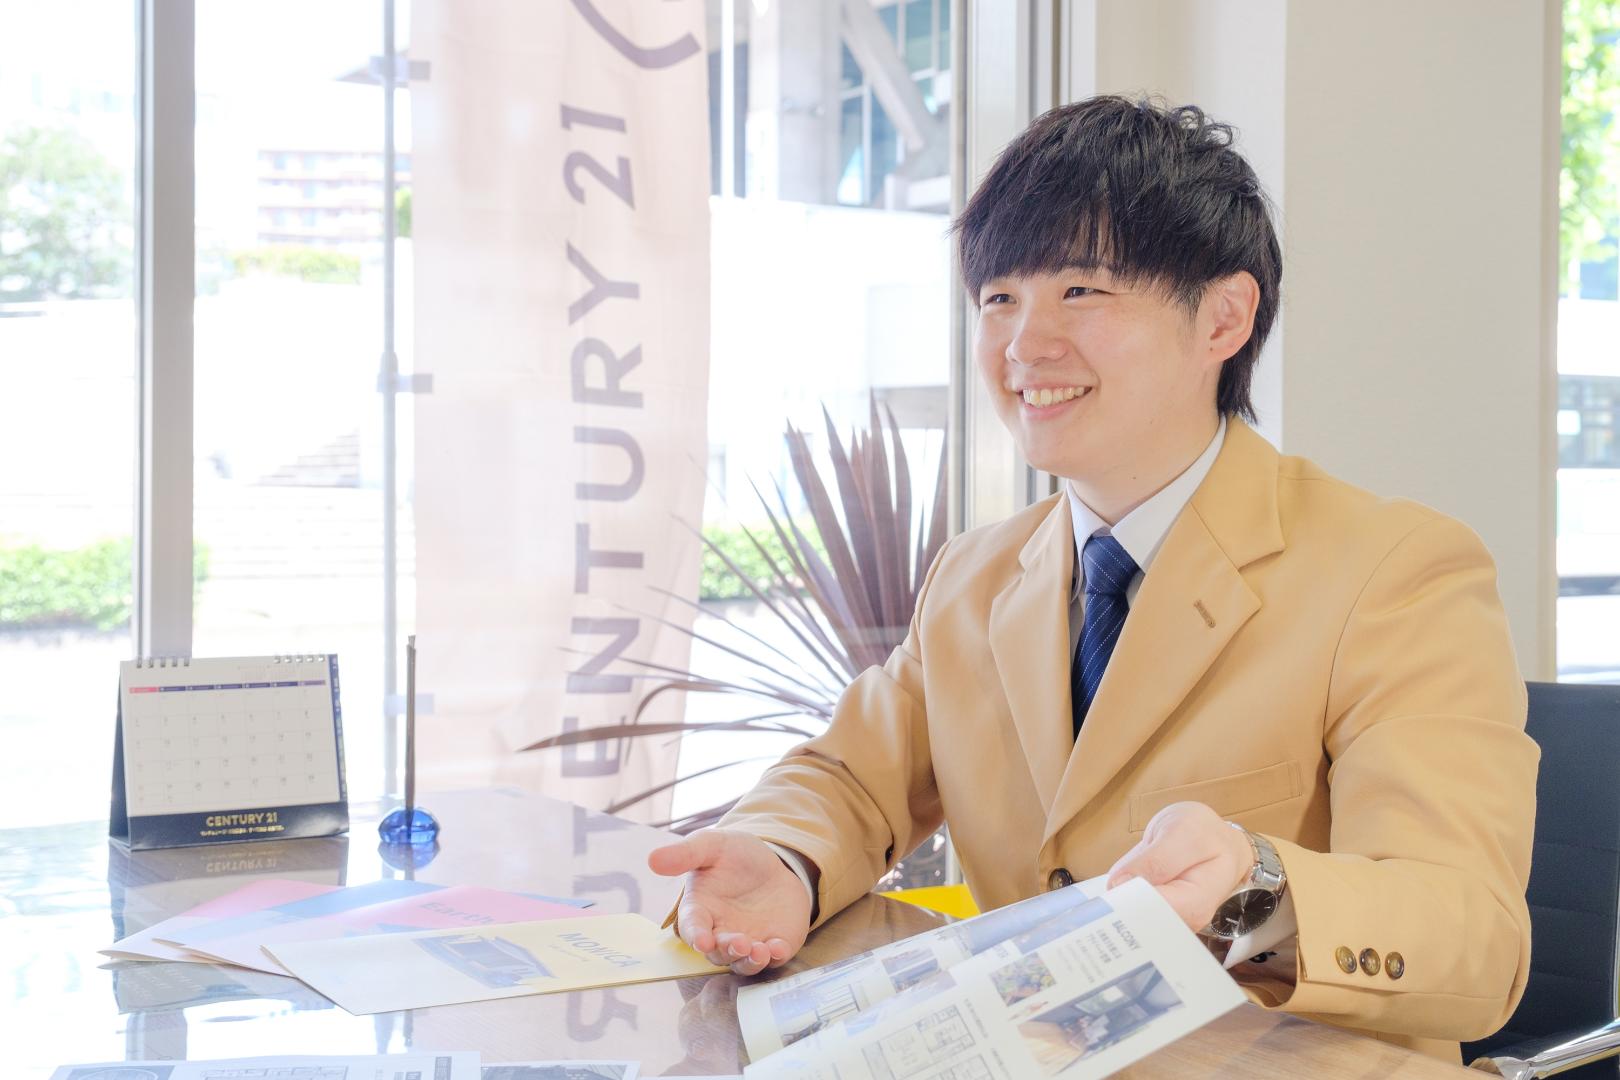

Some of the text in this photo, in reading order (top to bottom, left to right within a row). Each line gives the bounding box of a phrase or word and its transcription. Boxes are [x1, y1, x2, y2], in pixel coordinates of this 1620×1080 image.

[558, 102, 637, 210] 21
[560, 241, 645, 779] ENTURY
[206, 811, 278, 827] CENTURY 21
[558, 931, 642, 968] MONICA
[1112, 919, 1142, 950] BALCONY
